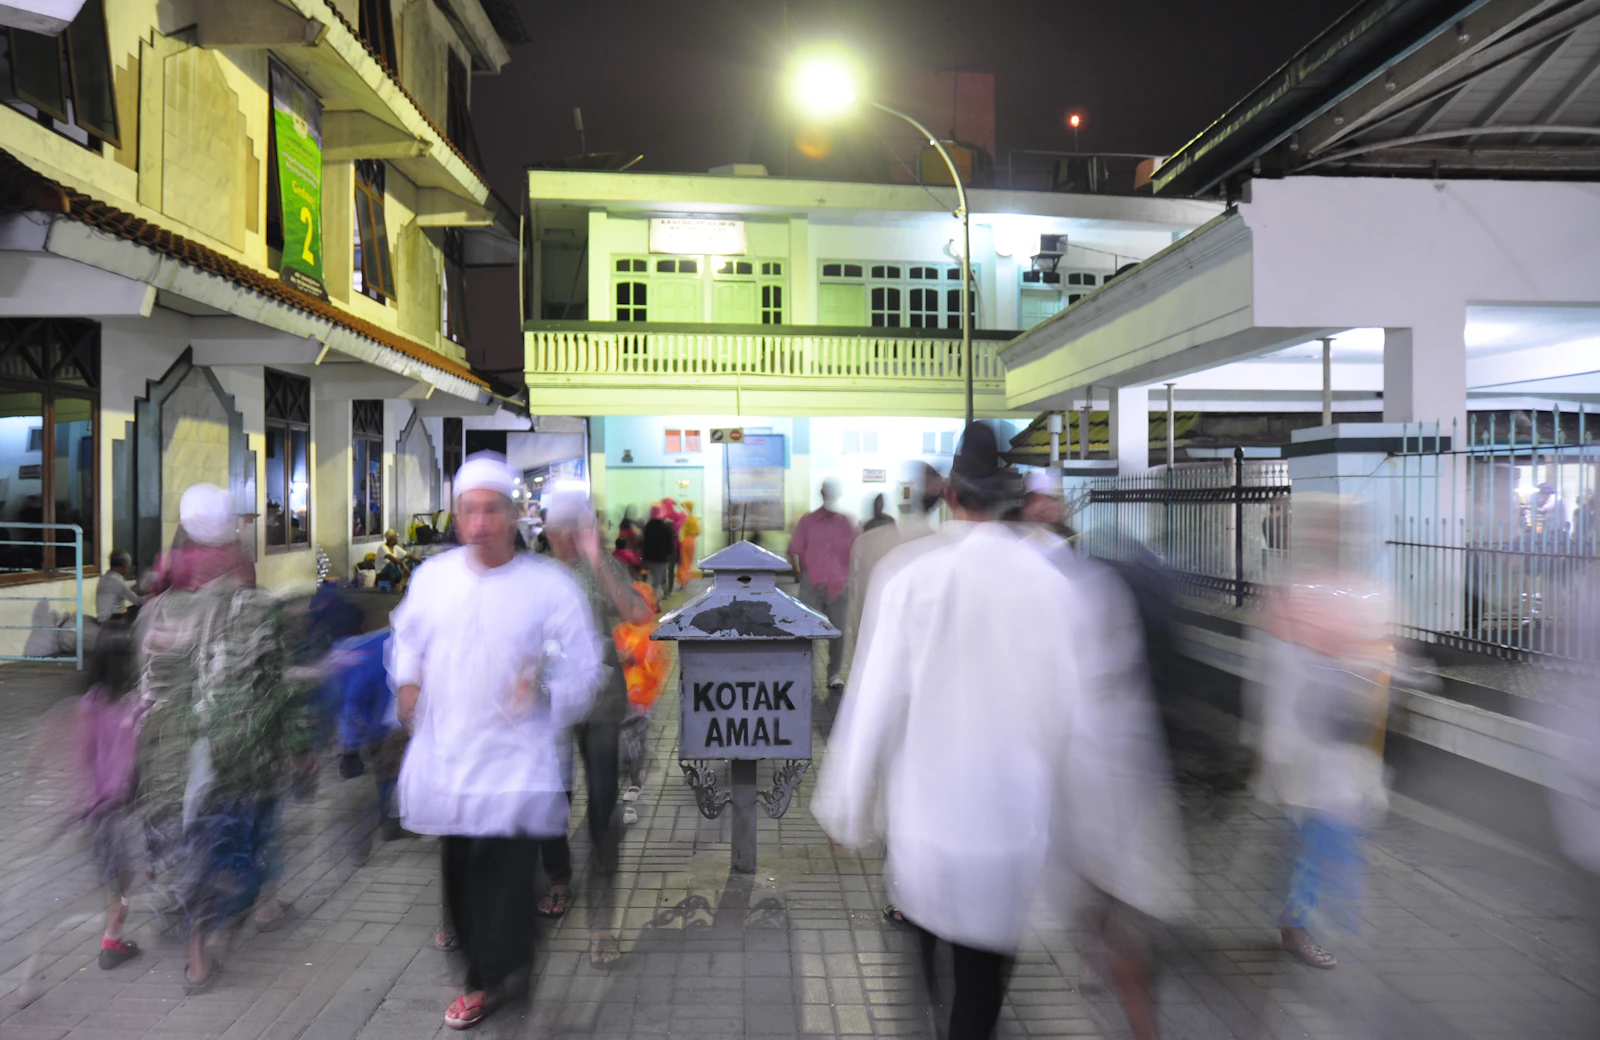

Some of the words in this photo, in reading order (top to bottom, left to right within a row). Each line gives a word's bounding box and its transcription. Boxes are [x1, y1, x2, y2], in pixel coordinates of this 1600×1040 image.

[300, 205, 314, 266] 2
[694, 681, 796, 711] KOTAK
[705, 717, 792, 747] AMAL
